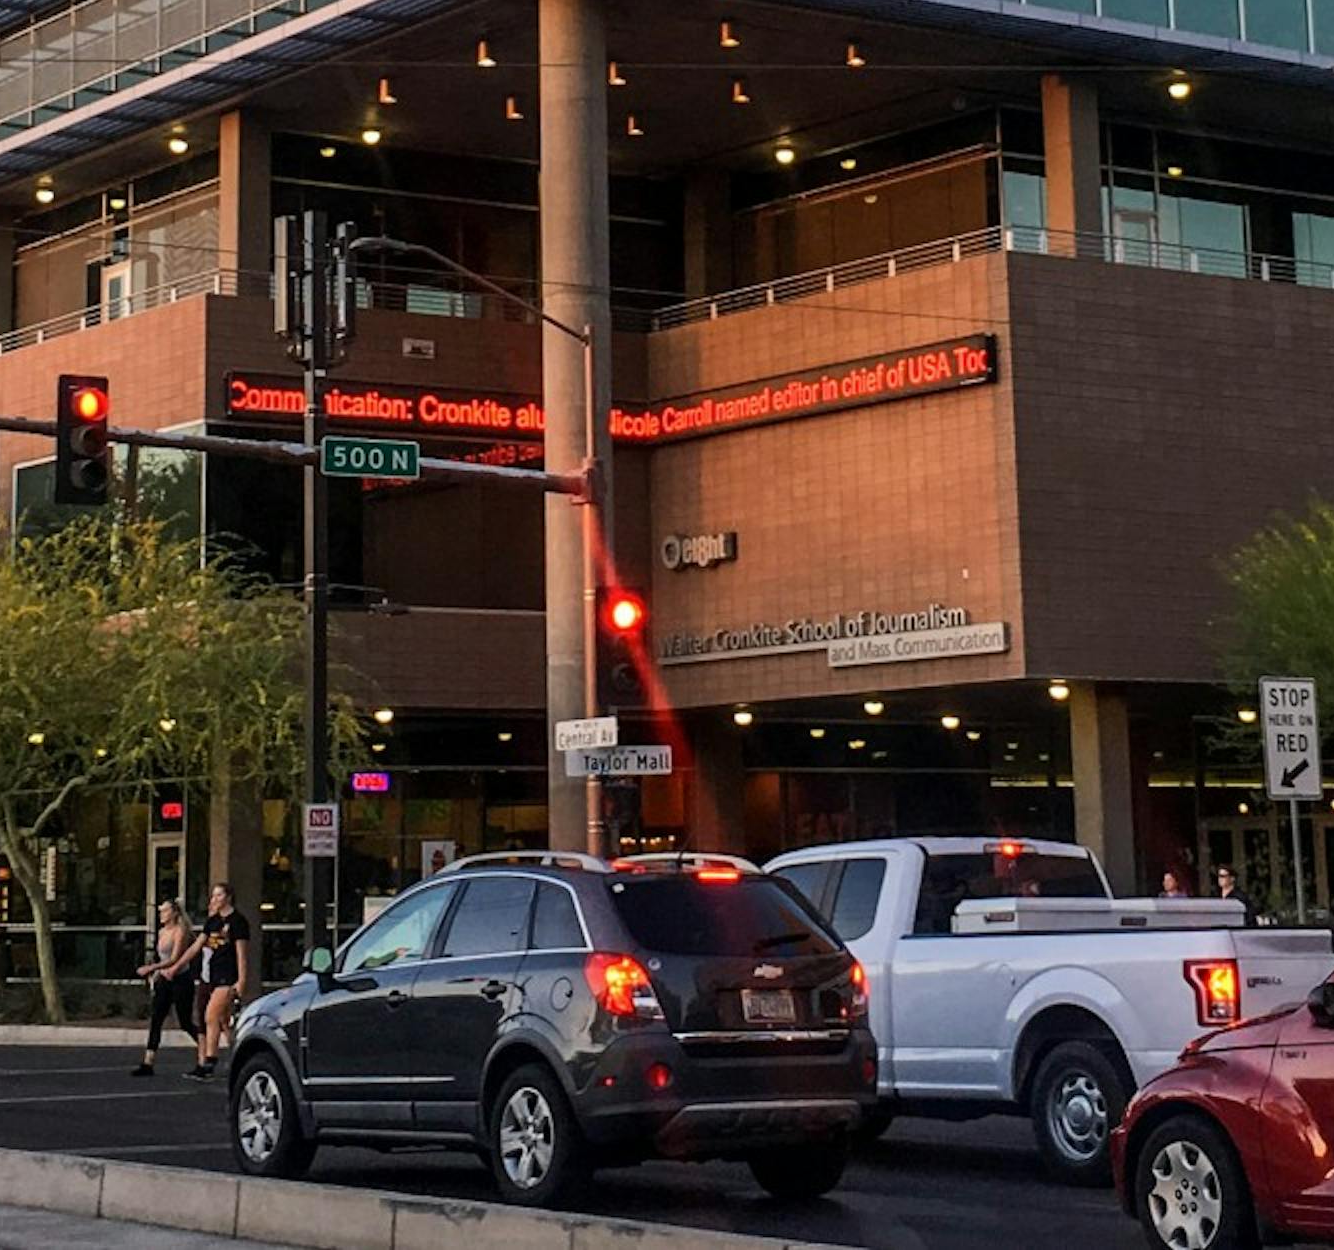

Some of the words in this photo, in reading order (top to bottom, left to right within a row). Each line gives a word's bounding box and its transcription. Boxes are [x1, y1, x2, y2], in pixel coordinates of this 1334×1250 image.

[232, 381, 414, 421] Commnication:
[419, 395, 512, 427] Cronkite
[662, 398, 713, 433] Carroll
[715, 387, 769, 421] named
[773, 382, 820, 412] editor
[822, 375, 838, 401] in
[842, 362, 885, 398] chief
[886, 359, 906, 388] of
[907, 351, 952, 384] USA
[333, 446, 384, 470] 500
[392, 449, 408, 471] N
[659, 633, 709, 658] Walter
[713, 622, 782, 651] Cronkite
[786, 613, 841, 644] School
[845, 611, 865, 637] of
[868, 604, 967, 636] Journalism
[831, 643, 855, 662] and
[858, 640, 892, 659] Mass
[894, 630, 1002, 656] Communication
[1269, 688, 1310, 707] STOP
[1269, 714, 1295, 726] HERE
[1298, 714, 1313, 727] ON
[558, 730, 597, 749] Central
[1277, 733, 1308, 752] RED
[584, 753, 630, 774] Taylor
[637, 753, 669, 770] Mall
[311, 810, 331, 826] NO
